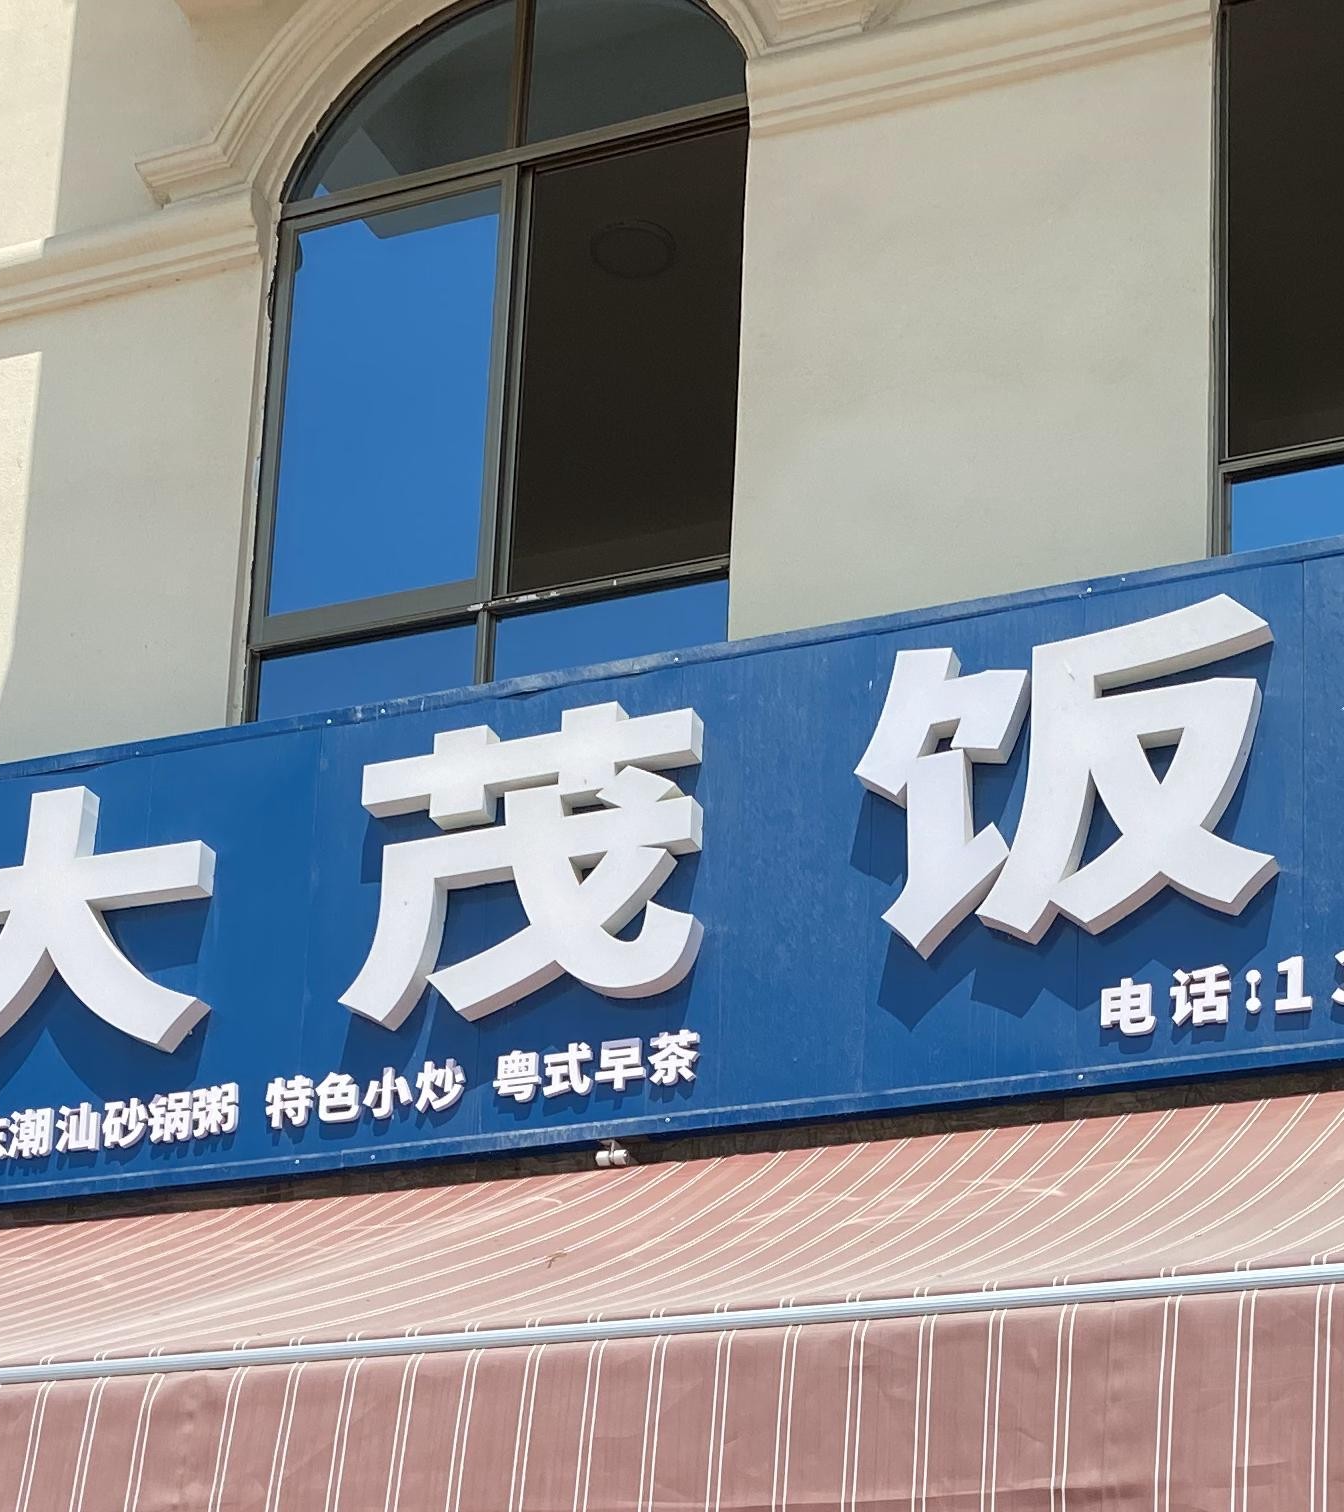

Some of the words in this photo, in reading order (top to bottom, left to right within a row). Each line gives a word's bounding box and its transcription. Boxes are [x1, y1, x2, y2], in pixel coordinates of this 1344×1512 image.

[264, 1058, 465, 1131] 特色小炒
[492, 1029, 702, 1105] 粤式早茶
